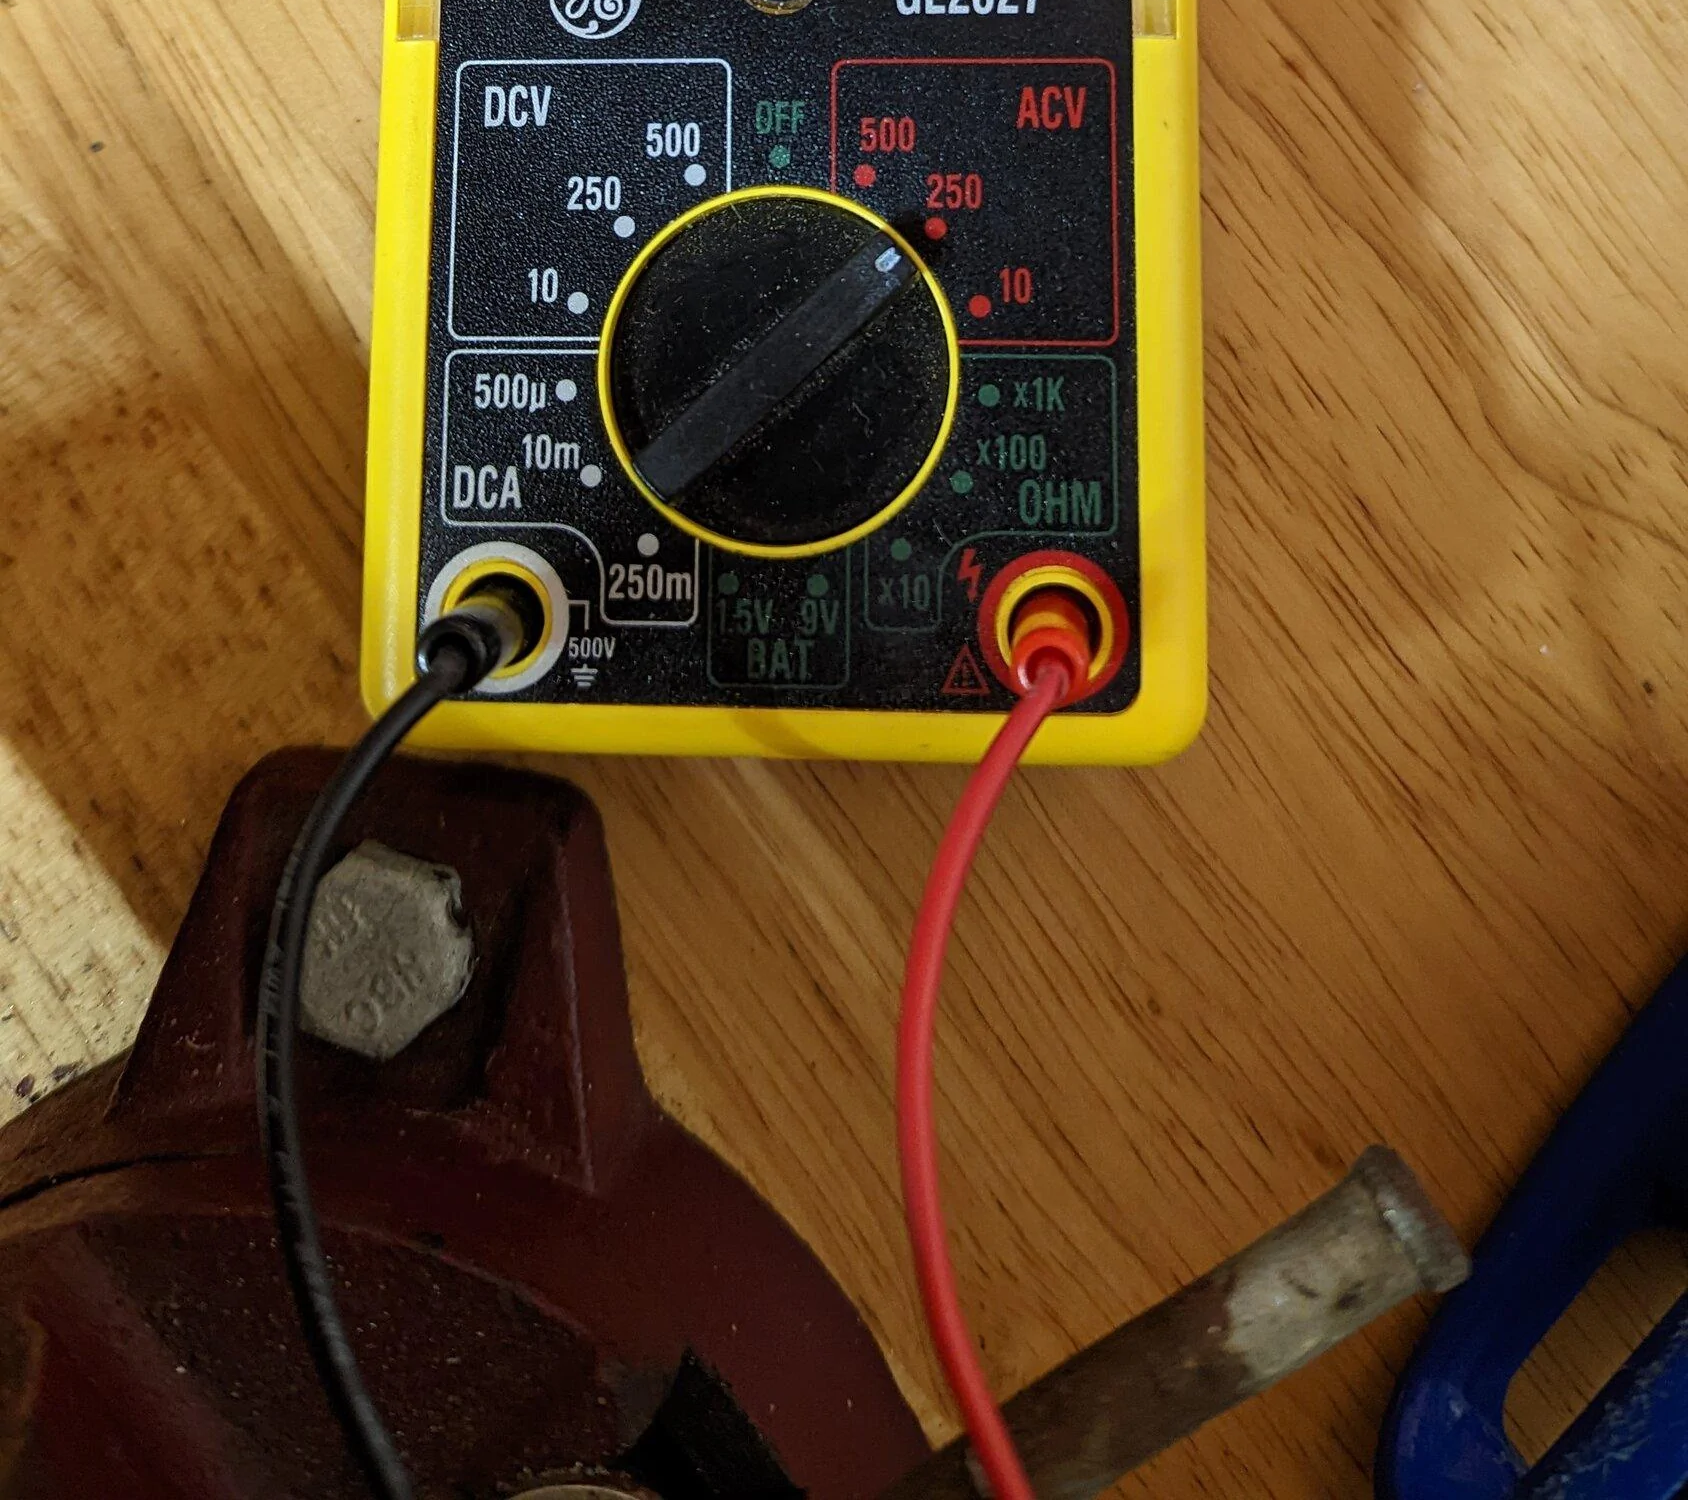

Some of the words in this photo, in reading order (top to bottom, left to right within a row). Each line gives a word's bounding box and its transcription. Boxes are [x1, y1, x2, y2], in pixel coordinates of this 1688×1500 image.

[484, 85, 551, 127] DCV
[756, 101, 804, 134] OFF
[1017, 86, 1087, 129] ACV
[647, 122, 700, 157] 500
[860, 117, 916, 152] 500
[567, 176, 621, 210] 250
[927, 174, 983, 209] 250
[528, 268, 558, 303] 10
[1000, 268, 1032, 303] 10
[522, 434, 580, 470] 10m
[976, 434, 1047, 470] x100
[453, 466, 522, 508] DCA
[1019, 479, 1100, 525] OHM
[609, 564, 692, 600] 250m
[802, 599, 839, 635] 9V
[568, 638, 615, 659] 500V
[748, 639, 814, 681] BAT
